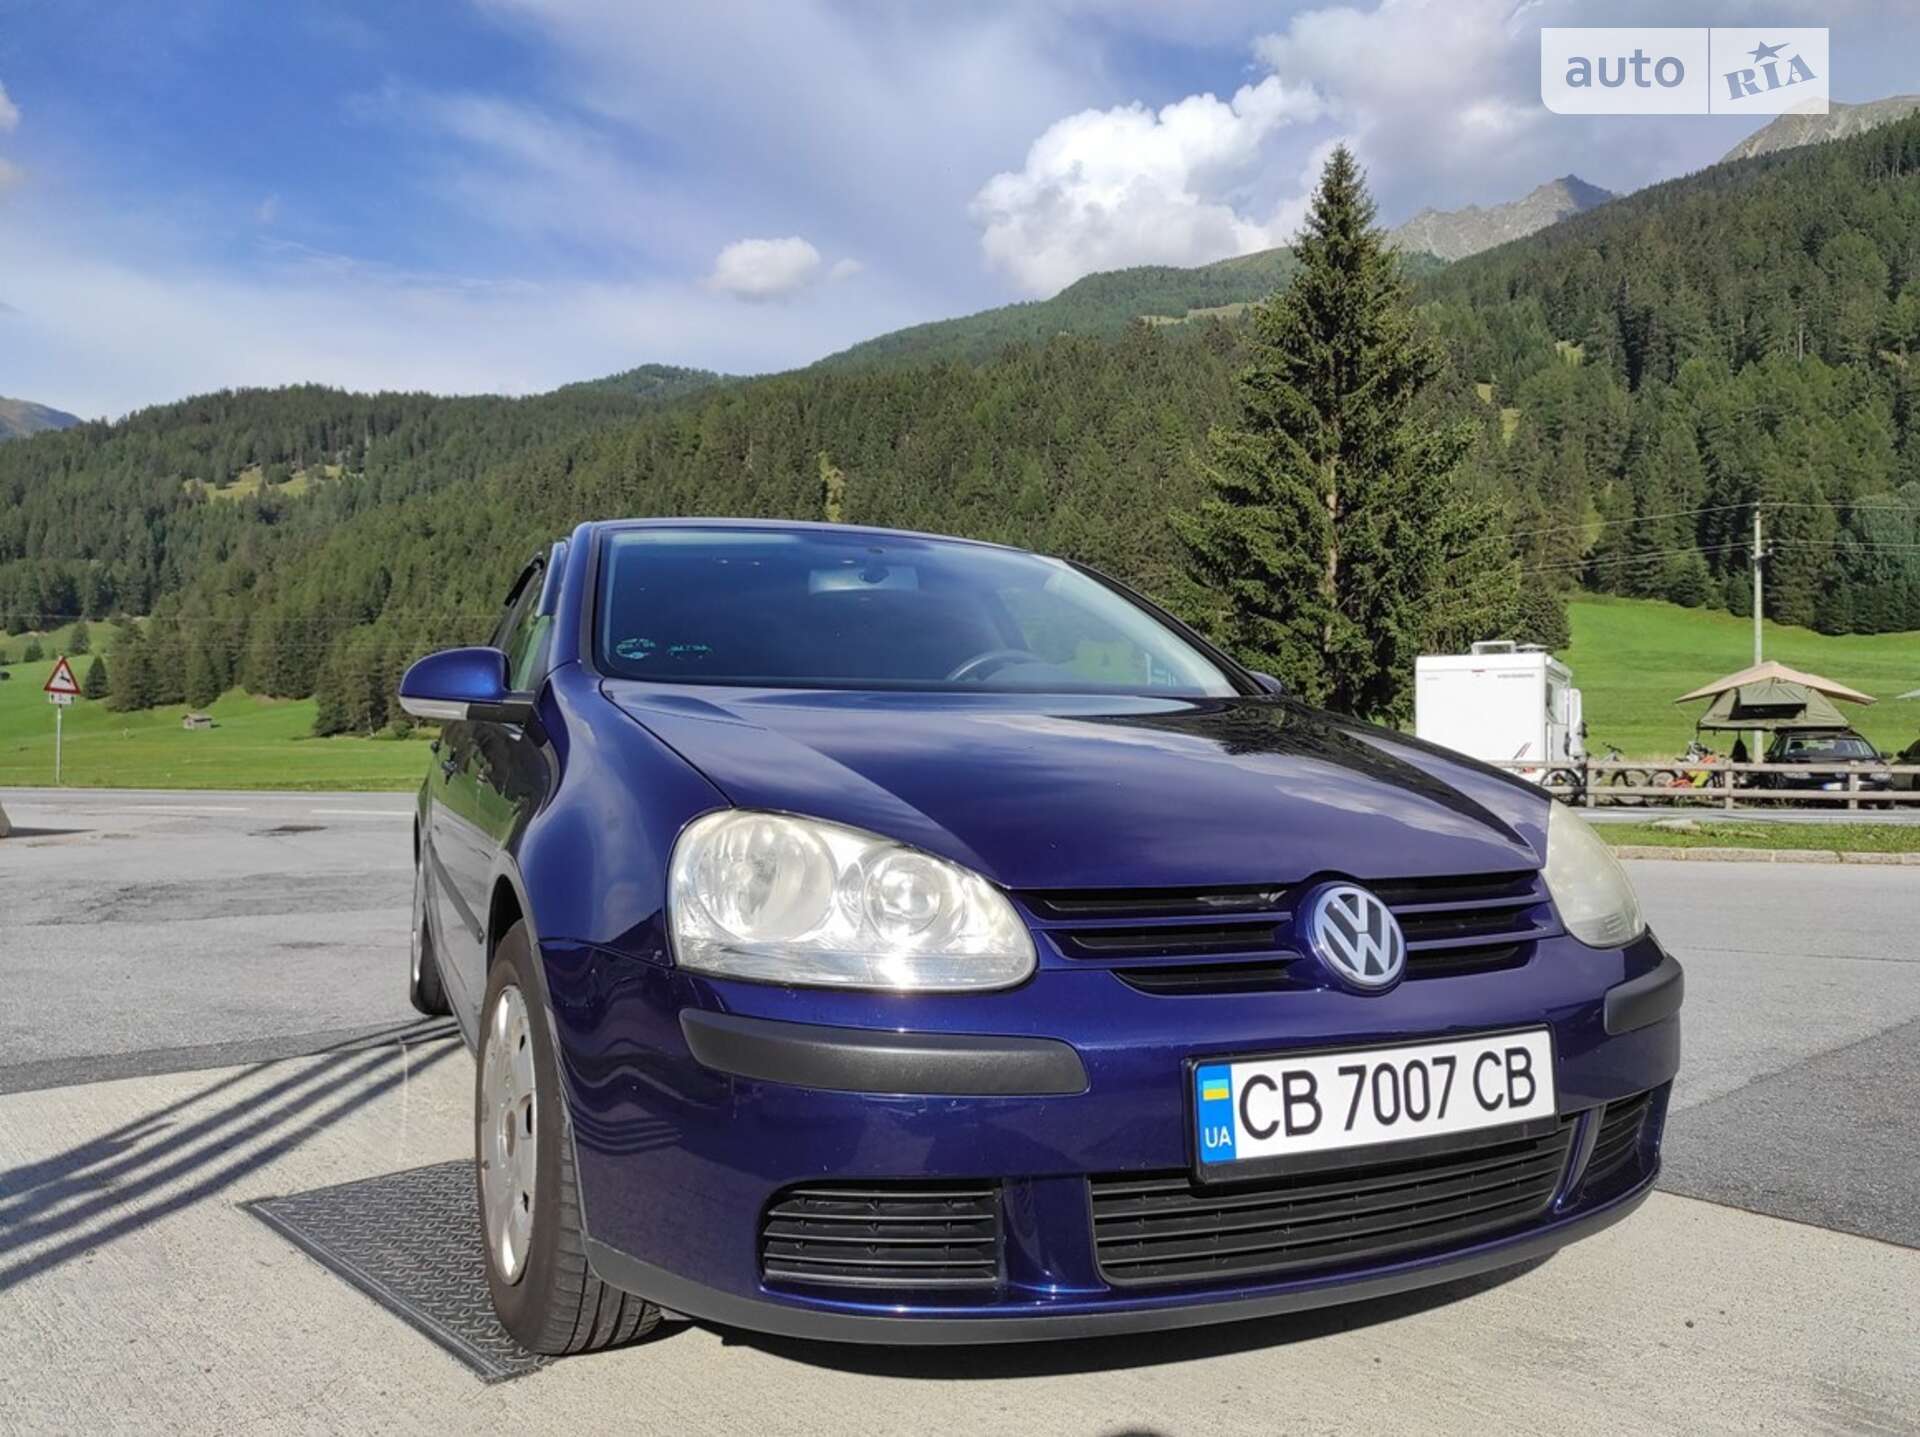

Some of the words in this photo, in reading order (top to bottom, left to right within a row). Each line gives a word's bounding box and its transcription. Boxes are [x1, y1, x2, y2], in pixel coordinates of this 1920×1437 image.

[1239, 1069, 1323, 1140] CB
[1338, 1055, 1457, 1131] 7007
[1472, 1046, 1536, 1111] CB
[1205, 1126, 1232, 1148] UA
